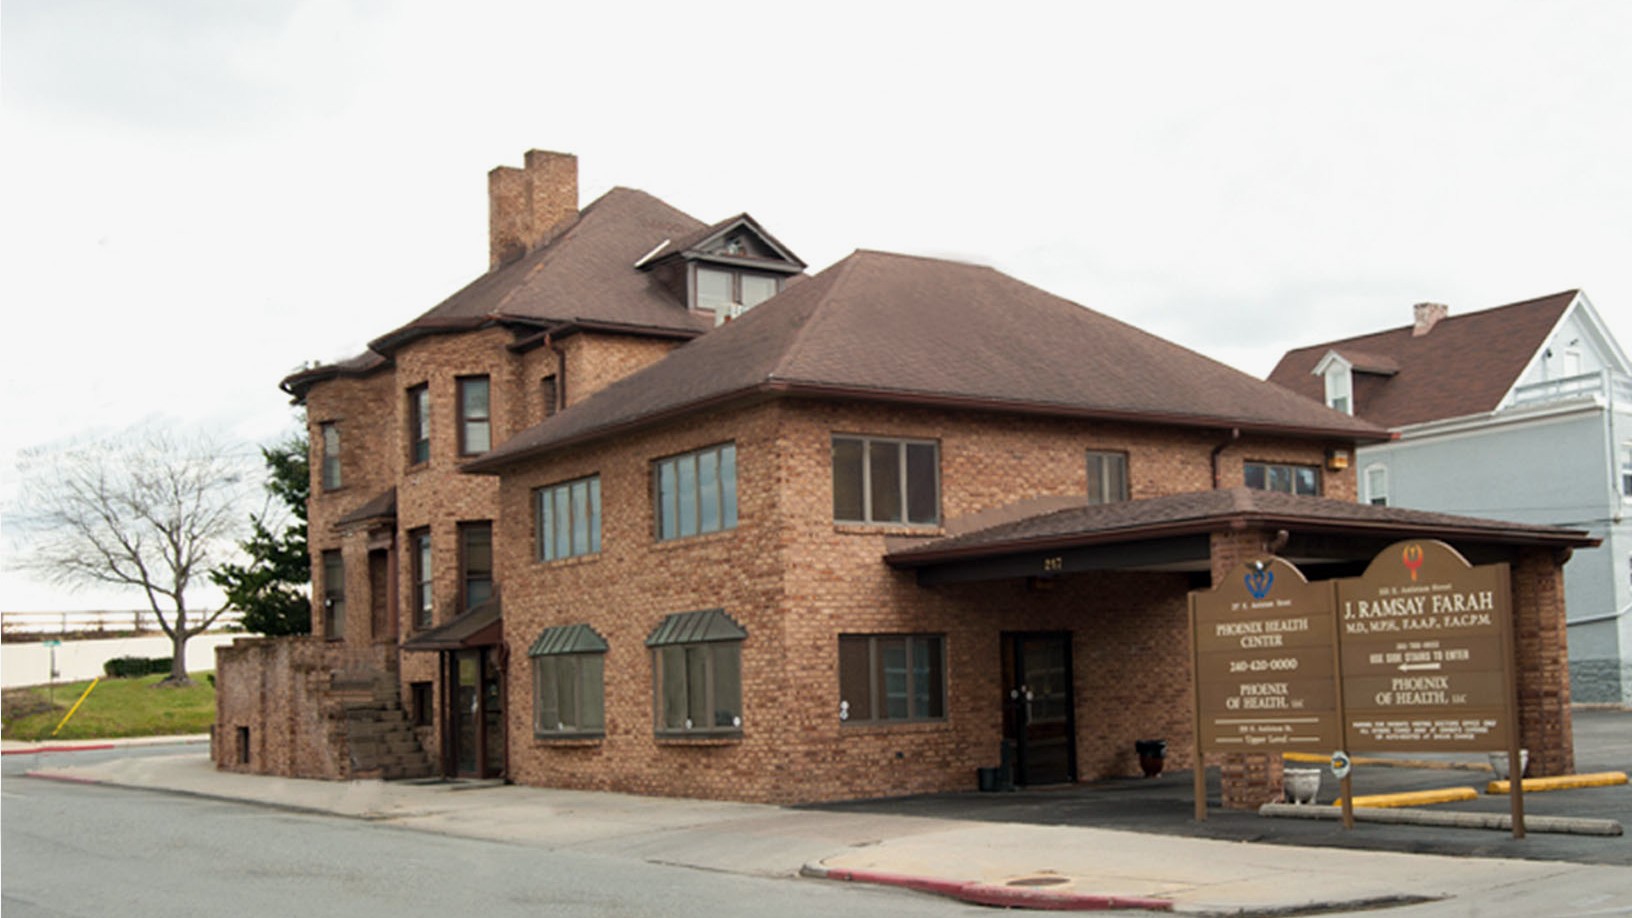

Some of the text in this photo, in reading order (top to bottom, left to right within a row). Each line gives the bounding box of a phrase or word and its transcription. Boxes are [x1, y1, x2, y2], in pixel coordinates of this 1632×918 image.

[1344, 591, 1494, 619] J. RAMSAY FARAH
[1216, 618, 1309, 636] PHOENIX HEALTH
[1240, 635, 1284, 648] CENTER
[1240, 683, 1289, 696] PHOENIX
[1392, 676, 1449, 691] PHOENIX
[1226, 698, 1241, 709] OF
[1375, 692, 1392, 705] OF
